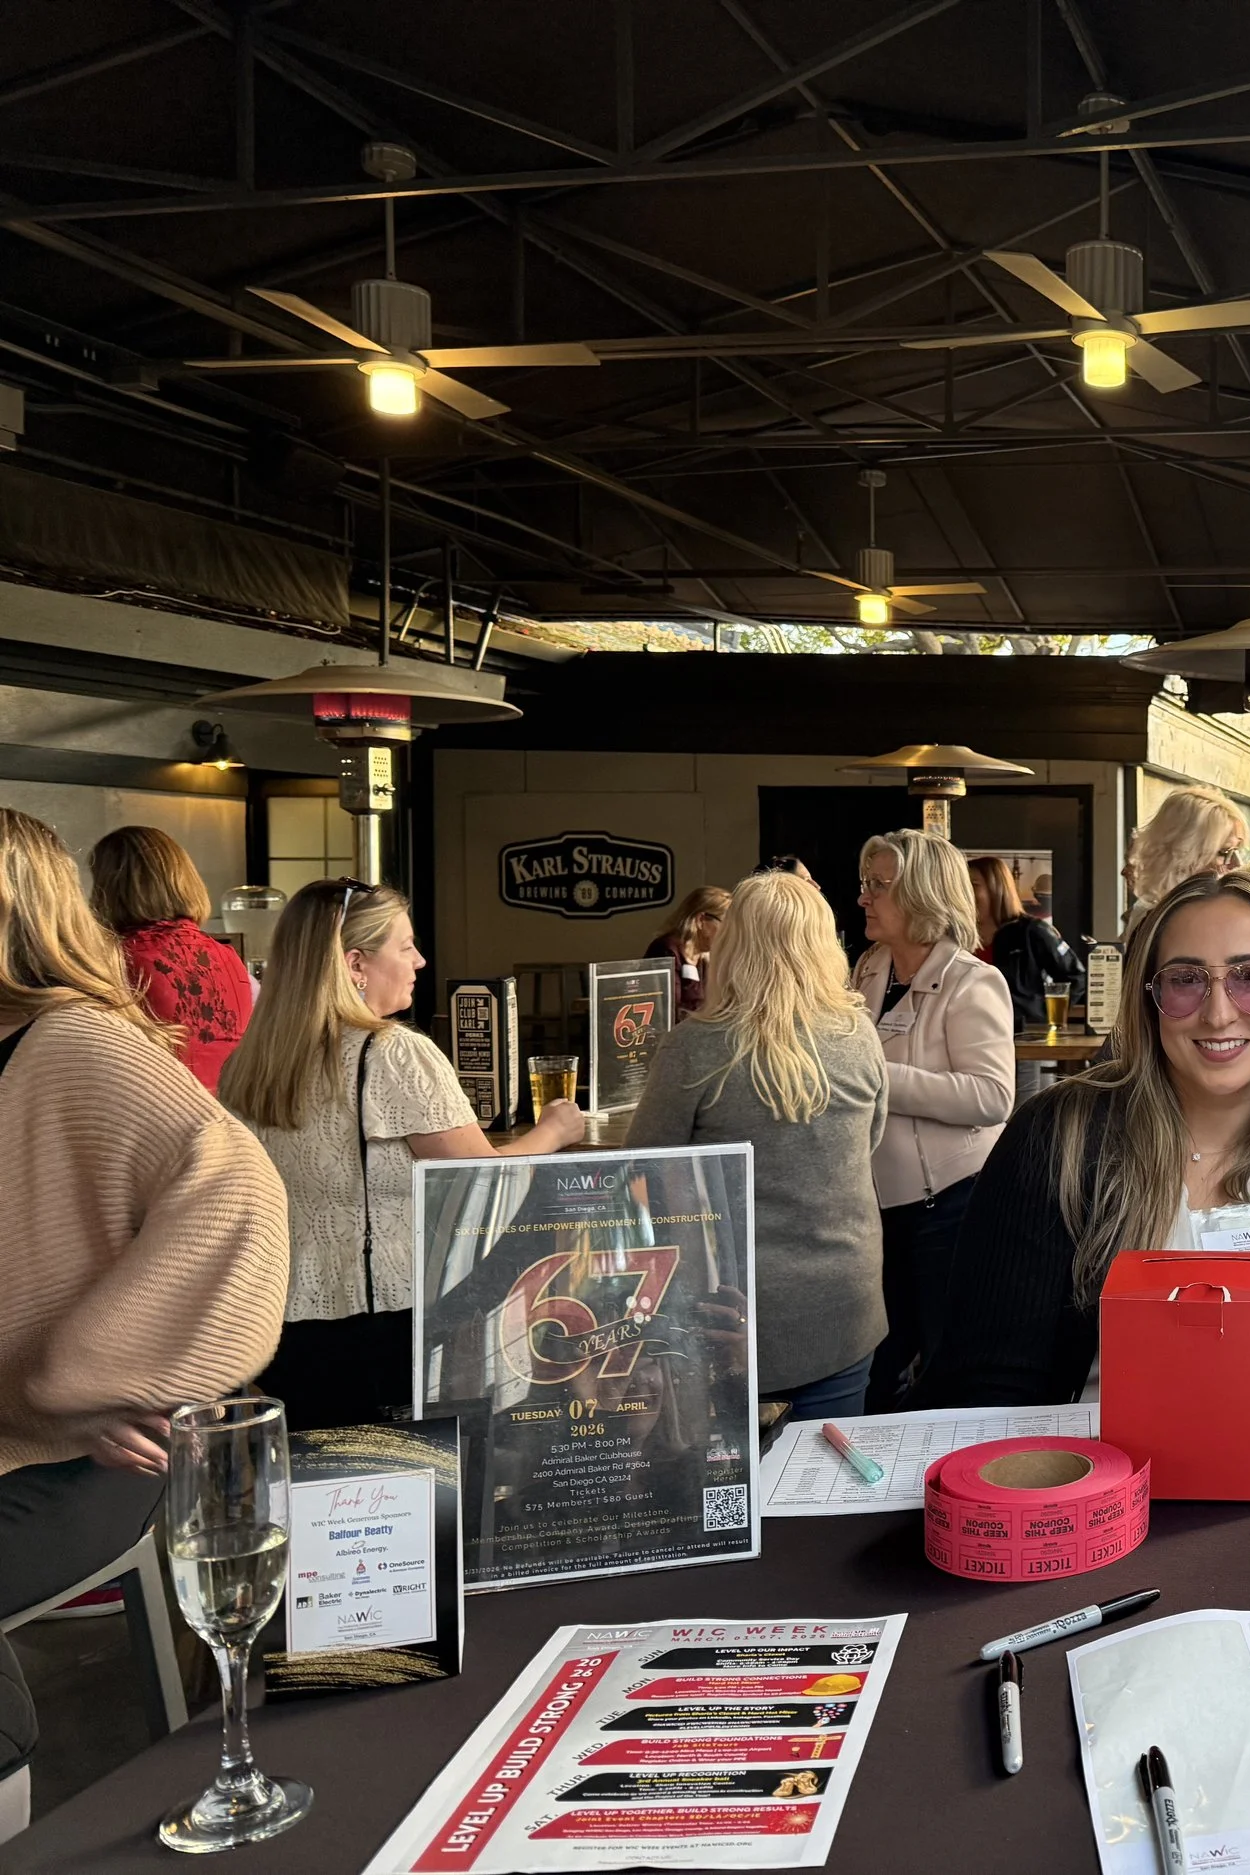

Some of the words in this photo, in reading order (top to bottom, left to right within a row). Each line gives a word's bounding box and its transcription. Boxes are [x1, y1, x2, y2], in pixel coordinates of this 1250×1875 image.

[509, 854, 569, 885] KARL
[572, 846, 663, 884] STRAUSS
[519, 886, 568, 898] BREWING
[605, 886, 654, 899] COMPANY
[459, 998, 476, 1007] JOIN
[459, 1008, 476, 1018] CLUB
[460, 1020, 476, 1029] KARL
[614, 1002, 655, 1048] 67
[557, 1170, 616, 1191] NAWIC
[518, 1225, 531, 1233] OF
[533, 1220, 598, 1231] EMPOWERING
[599, 1218, 636, 1228] WOMEN
[650, 1213, 722, 1224] CONSTRUCTION
[499, 1245, 680, 1385] 67
[576, 1321, 643, 1357] YEARS
[510, 1409, 561, 1421] TUESDAY
[569, 1398, 599, 1420] 07
[616, 1402, 648, 1412] APRIL
[570, 1423, 605, 1437] 2026
[571, 1442, 587, 1450] PM
[616, 1437, 631, 1446] PM
[541, 1456, 573, 1466] Admiral
[575, 1455, 597, 1463] Baker
[599, 1450, 642, 1460] Clubhouse
[532, 1471, 553, 1479] 2400
[554, 1466, 586, 1476] Admiral
[587, 1465, 610, 1473] Baker
[612, 1462, 624, 1470] Rd
[553, 1480, 568, 1488] San
[570, 1477, 594, 1487] Diego
[595, 1476, 607, 1484] CA
[608, 1474, 631, 1484] 92124
[570, 1487, 606, 1496] Tickets
[325, 1484, 366, 1517] Thank
[368, 1484, 399, 1515] You
[525, 1503, 543, 1511] $75
[547, 1498, 592, 1509] Members
[625, 1491, 653, 1501] Guest
[1092, 1500, 1122, 1518] COUPON
[1106, 1507, 1126, 1524] KEEP
[327, 1517, 346, 1525] Week
[347, 1514, 380, 1524] Generous
[380, 1511, 412, 1521] Sponsors
[498, 1525, 519, 1533] Join
[551, 1516, 599, 1527] celebrate
[602, 1513, 619, 1521] Our
[623, 1508, 670, 1519] Milestone
[965, 1519, 1004, 1530] COUPON
[1029, 1516, 1070, 1529] COUPON
[1088, 1516, 1103, 1528] THIS
[329, 1528, 362, 1540] Balfour
[364, 1524, 394, 1537] Beatty
[538, 1527, 584, 1537] Company
[624, 1520, 657, 1529] Design
[659, 1515, 700, 1524] Drafting
[961, 1526, 983, 1536] THIS
[1024, 1528, 1046, 1538] THIS
[1050, 1523, 1074, 1536] KEEP
[501, 1539, 562, 1552] Competition
[575, 1531, 633, 1544] Scholarship
[636, 1527, 671, 1537] Awards
[986, 1529, 1009, 1538] KEEP
[336, 1548, 361, 1557] Albireo
[651, 1546, 675, 1554] cancel
[1091, 1539, 1122, 1562] TICKET
[389, 1559, 425, 1568] OneSource
[964, 1561, 1006, 1575] TICKET
[1028, 1559, 1072, 1574] TICKET
[298, 1571, 318, 1579] mpe
[355, 1587, 387, 1597] Dynalectric
[393, 1582, 427, 1594] WRIGHT
[318, 1592, 342, 1600] Baker
[337, 1604, 383, 1625] NAWIC
[587, 1629, 653, 1640] NAWIC
[672, 1628, 726, 1637] WIC
[746, 1625, 828, 1634] WEEK
[577, 1658, 602, 1667] 20
[570, 1669, 593, 1677] 26
[441, 1807, 496, 1853] LEVEL
[478, 1782, 511, 1803] UP
[495, 1737, 544, 1779] BUILD
[528, 1681, 584, 1734] STRONG
